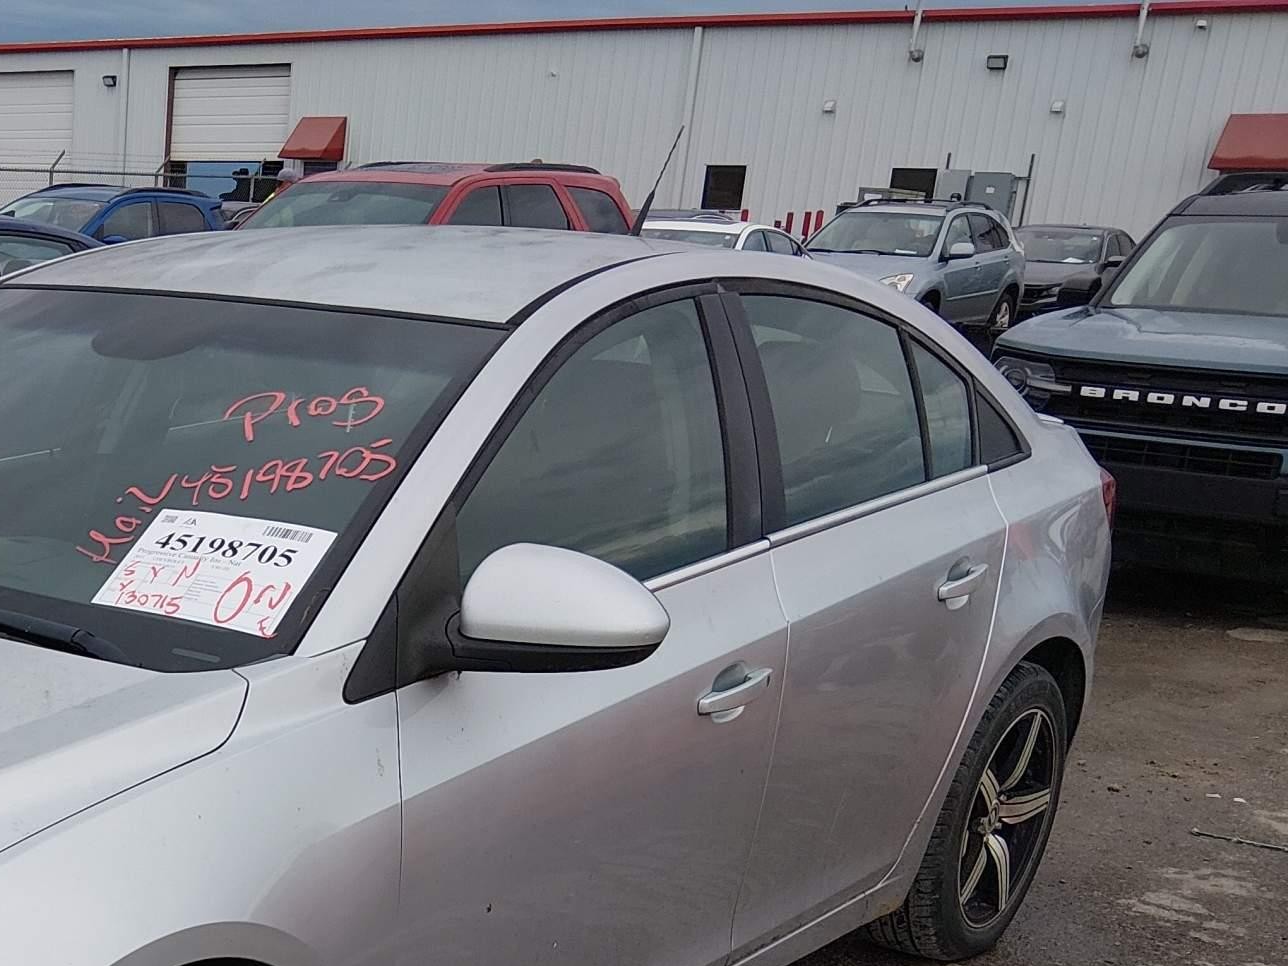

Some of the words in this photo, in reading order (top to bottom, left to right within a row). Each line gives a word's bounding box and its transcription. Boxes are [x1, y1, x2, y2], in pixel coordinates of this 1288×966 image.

[1079, 386, 1287, 415] BRONCO
[180, 438, 397, 506] 45198705
[155, 531, 300, 568] 45198705
